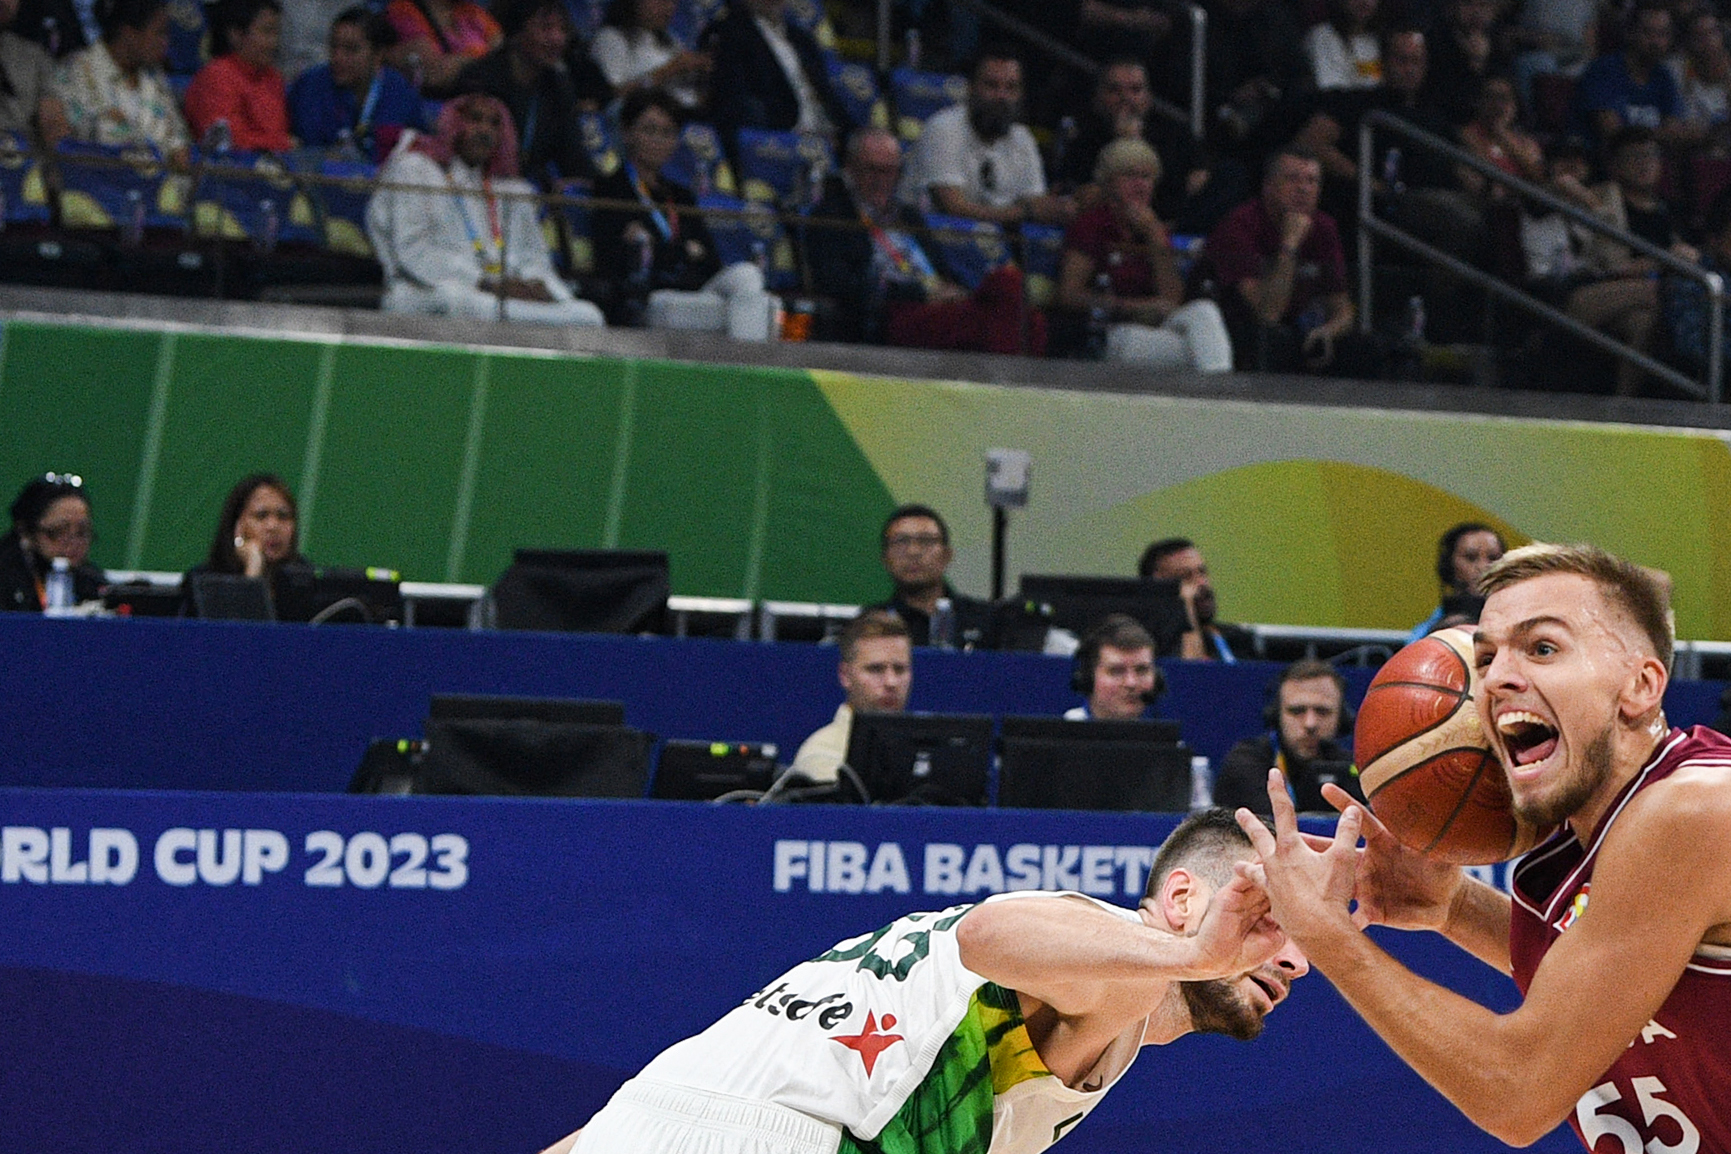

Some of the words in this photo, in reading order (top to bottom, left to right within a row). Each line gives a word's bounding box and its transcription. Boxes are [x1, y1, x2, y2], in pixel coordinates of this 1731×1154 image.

[0, 826, 138, 884] RLD
[155, 828, 288, 885] CUP
[304, 831, 469, 889] 2023
[773, 840, 911, 893] FIBA
[923, 843, 1157, 896] BASKET
